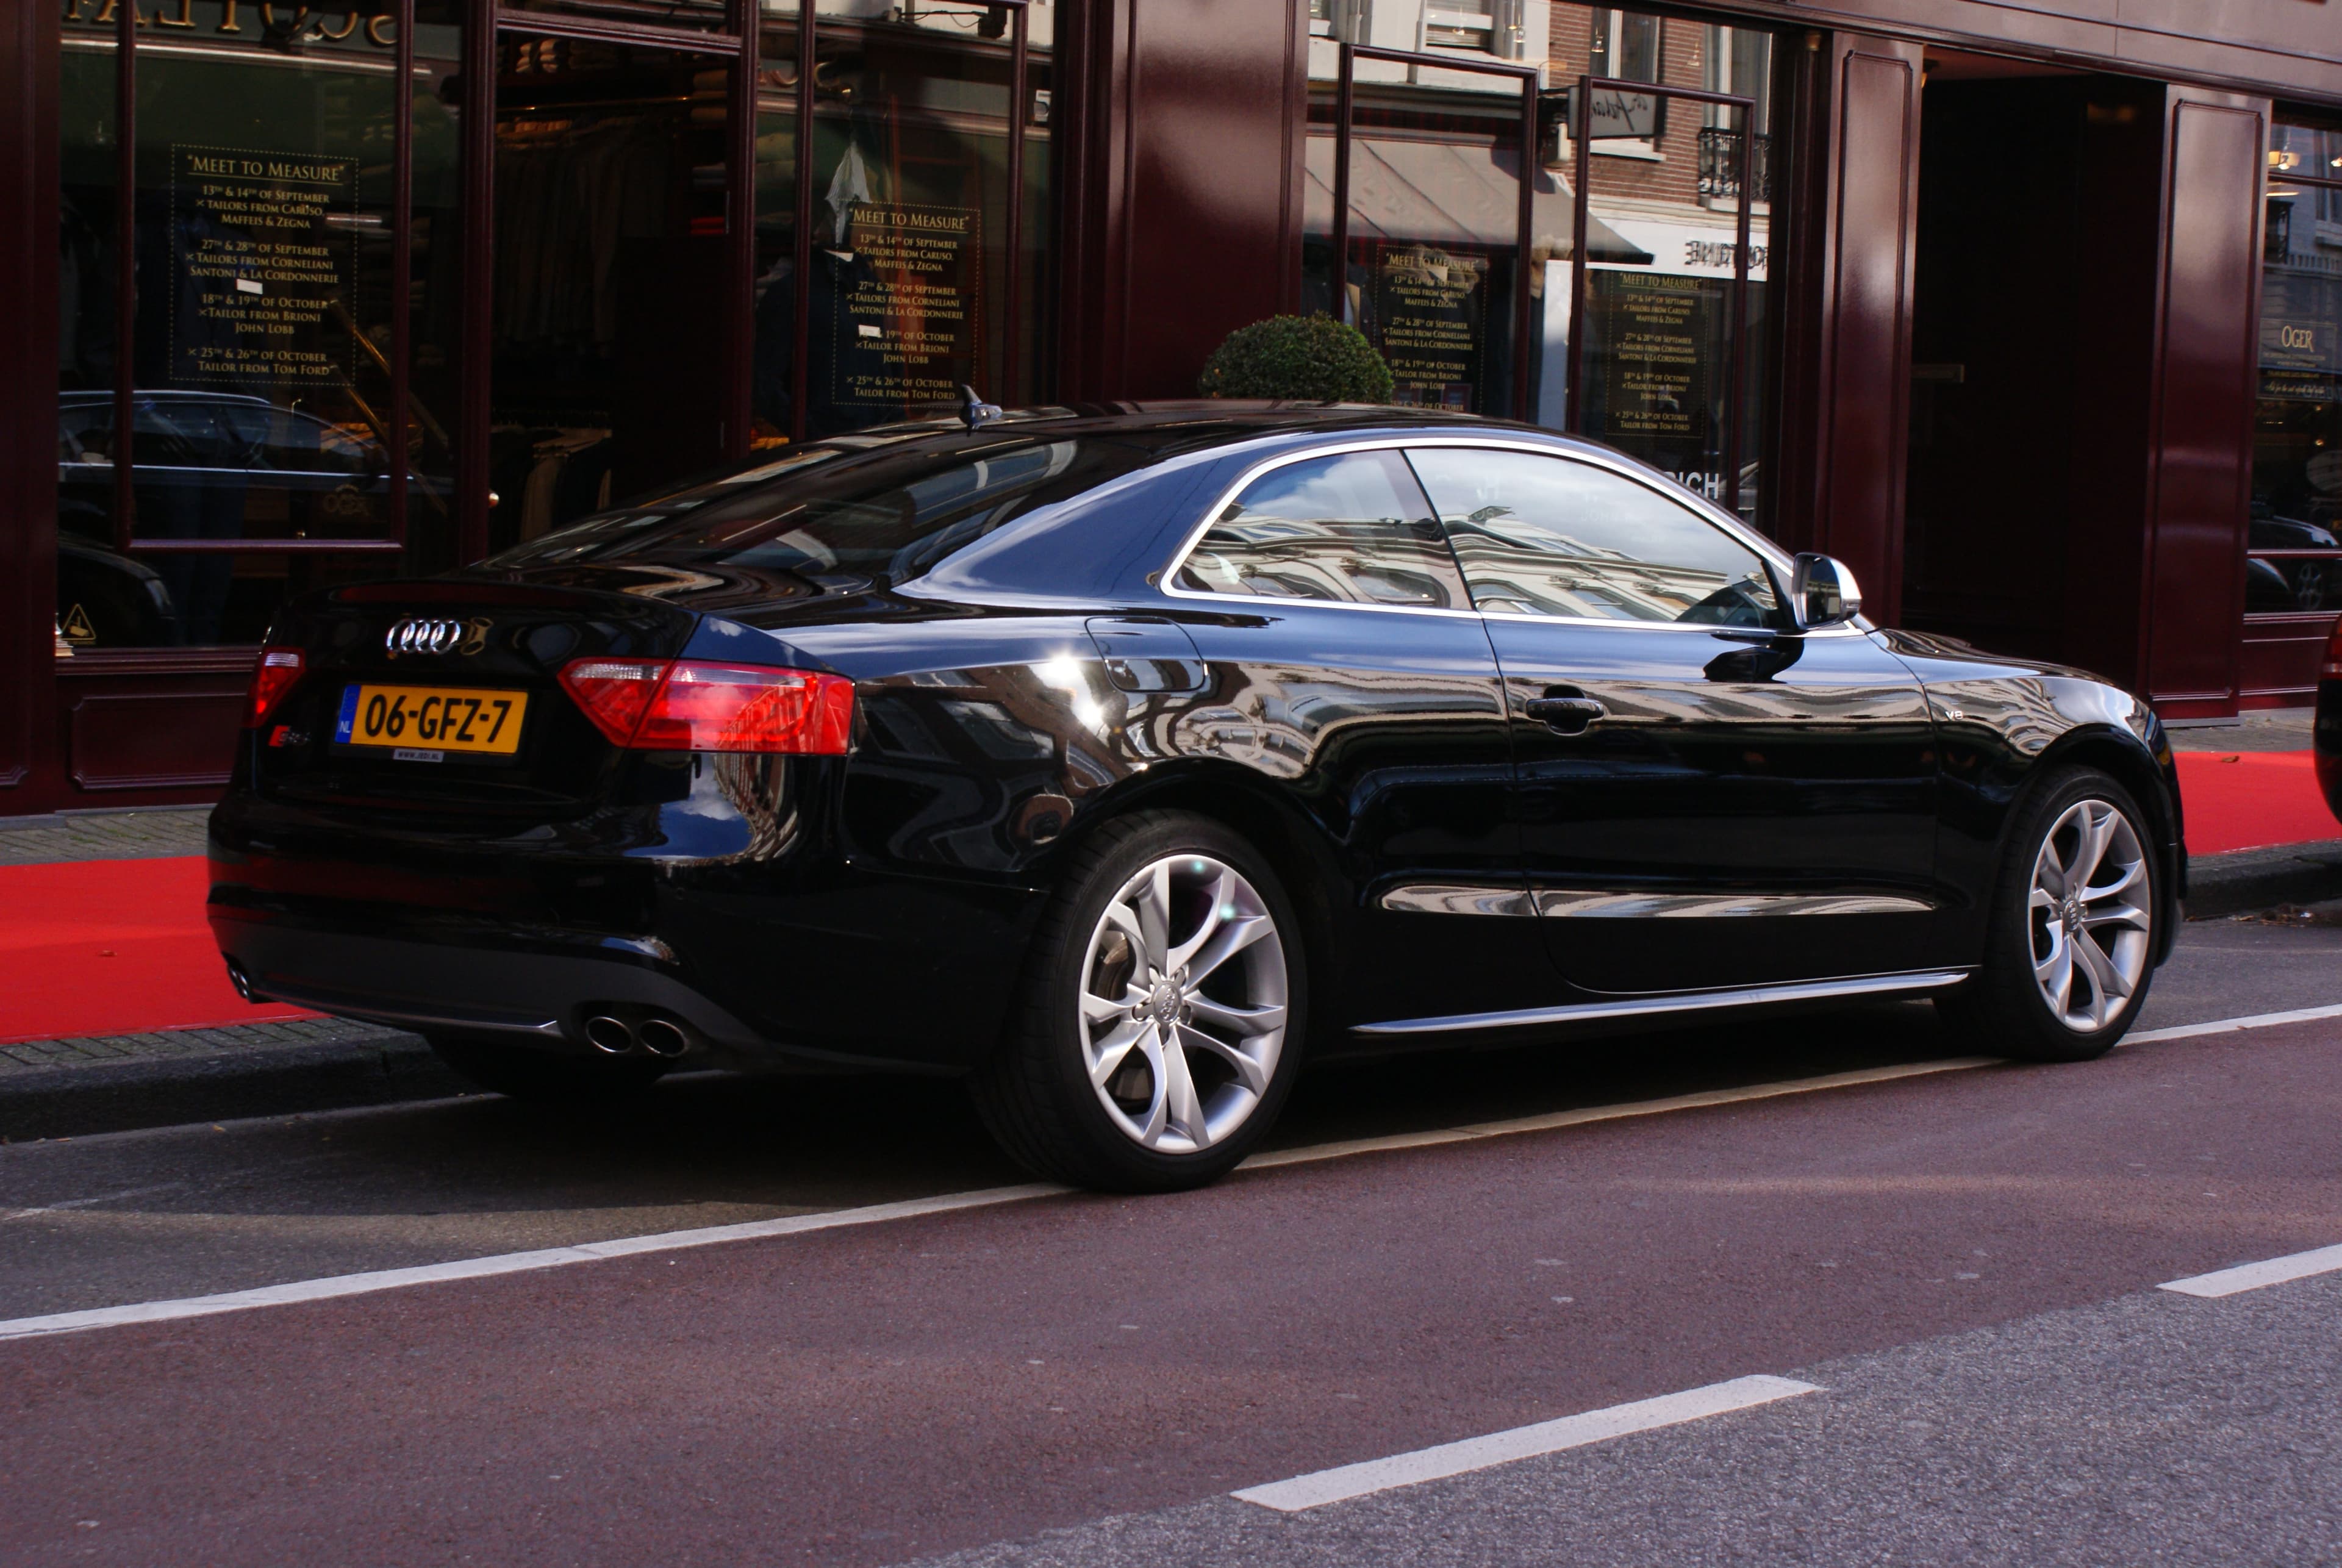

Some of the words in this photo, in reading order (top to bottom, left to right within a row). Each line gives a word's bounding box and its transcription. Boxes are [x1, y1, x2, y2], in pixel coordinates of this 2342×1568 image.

[241, 160, 263, 175] TO
[225, 186, 234, 196] &
[259, 188, 273, 199] OF
[275, 190, 330, 203] SEPTEMBER
[207, 199, 246, 211] TAILORS
[251, 202, 278, 213] FROM
[220, 213, 262, 225] MAFFEIS
[266, 217, 274, 226] &
[277, 217, 310, 228] ZEGNA
[890, 212, 907, 225] TO
[224, 240, 233, 251] &
[258, 243, 273, 253] OF
[274, 243, 329, 256] SEPTEMBER
[903, 237, 914, 246] OF
[915, 238, 958, 249] SEPTEMBER
[864, 246, 893, 256] TAILORS
[897, 249, 918, 258] FROM
[196, 253, 237, 264] TAILORS
[240, 256, 268, 266] FROM
[271, 257, 333, 270] CORNELIANI
[873, 259, 906, 269] MAFFEIS
[916, 262, 942, 271] ZEGNA
[190, 266, 235, 277] SANTONI
[238, 269, 247, 278] &
[251, 270, 262, 279] LA
[265, 270, 338, 283] CORDONNERIE
[901, 284, 913, 293] OF
[914, 285, 956, 295] SEPTEMBER
[226, 295, 234, 304] &
[261, 296, 275, 306] OF
[278, 297, 328, 309] OCTOBER
[854, 293, 886, 303] TAILORS
[888, 295, 909, 304] FROM
[912, 297, 959, 307] CORNELIANI
[208, 307, 245, 318] TAILOR
[249, 309, 279, 320] FROM
[283, 311, 320, 322] BRIONI
[850, 305, 884, 315] SANTONI
[896, 307, 904, 316] LA
[906, 308, 963, 319] CORDONNERIE
[235, 322, 263, 335] JOHN
[268, 324, 294, 334] LOBB
[903, 331, 914, 340] OF
[917, 331, 954, 342] OCTOBER
[2282, 325, 2315, 353] OGER
[863, 341, 891, 350] TAILOR
[894, 342, 917, 351] FROM
[920, 343, 948, 353] BRIONI
[225, 348, 233, 358] &
[260, 350, 274, 360] OF
[278, 351, 327, 362] OCTOBER
[883, 353, 905, 365] JOHN
[909, 354, 928, 364] LOBB
[198, 361, 235, 371] TAILOR
[239, 362, 268, 373] FROM
[273, 363, 296, 374] TOM
[300, 365, 329, 375] FORD
[902, 378, 913, 386] OF
[915, 378, 953, 388] OCTOBER
[854, 387, 883, 396] TAILOR
[886, 388, 908, 398] FROM
[912, 390, 929, 398] TOM
[933, 391, 955, 399] FORD
[365, 693, 512, 743] 06-GFZ-7
[1945, 711, 1963, 720] V8
[338, 720, 351, 733] NL
